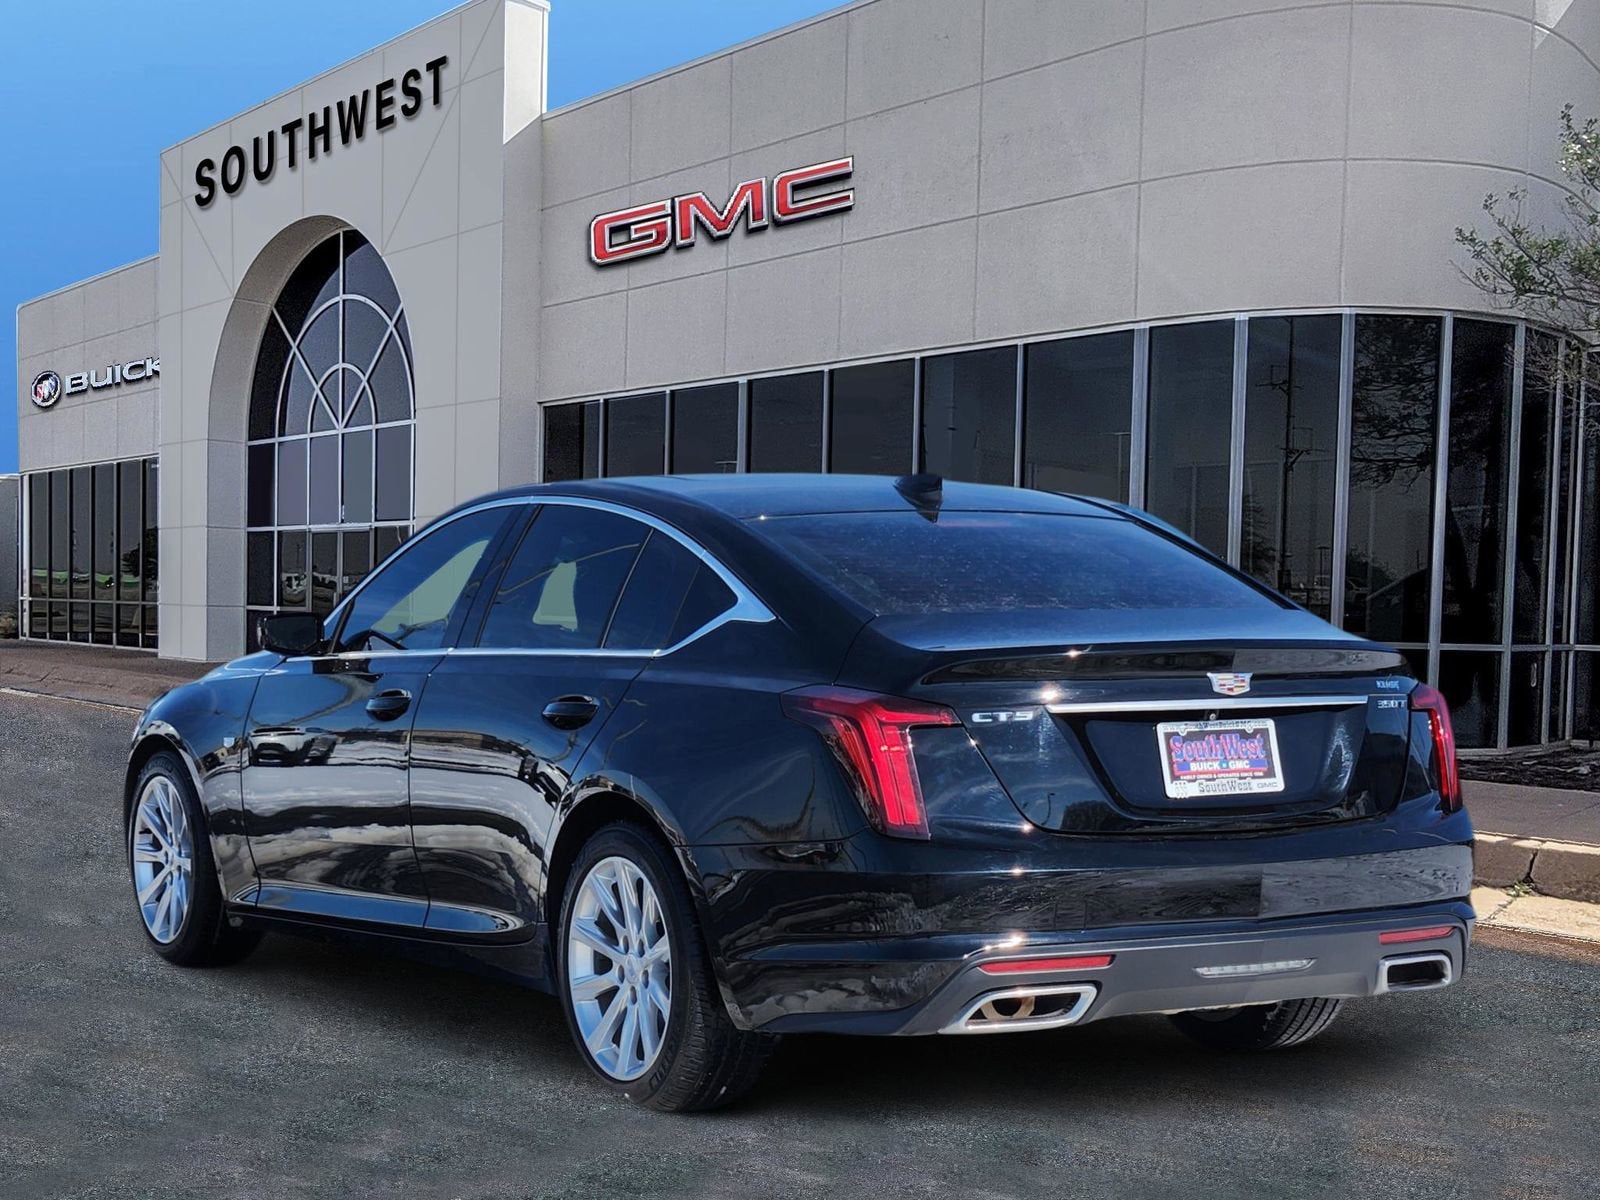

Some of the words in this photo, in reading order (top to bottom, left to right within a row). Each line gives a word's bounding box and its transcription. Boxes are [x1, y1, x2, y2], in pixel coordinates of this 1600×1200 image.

[194, 54, 448, 208] SOUTHWEST
[588, 154, 855, 268] GMC
[64, 356, 160, 396] BUICK
[1169, 733, 1267, 762] SouthWest
[1189, 760, 1220, 772] BUICK
[1228, 758, 1251, 770] GMC
[1198, 780, 1254, 794] SouthWest
[1256, 781, 1279, 789] GMC
